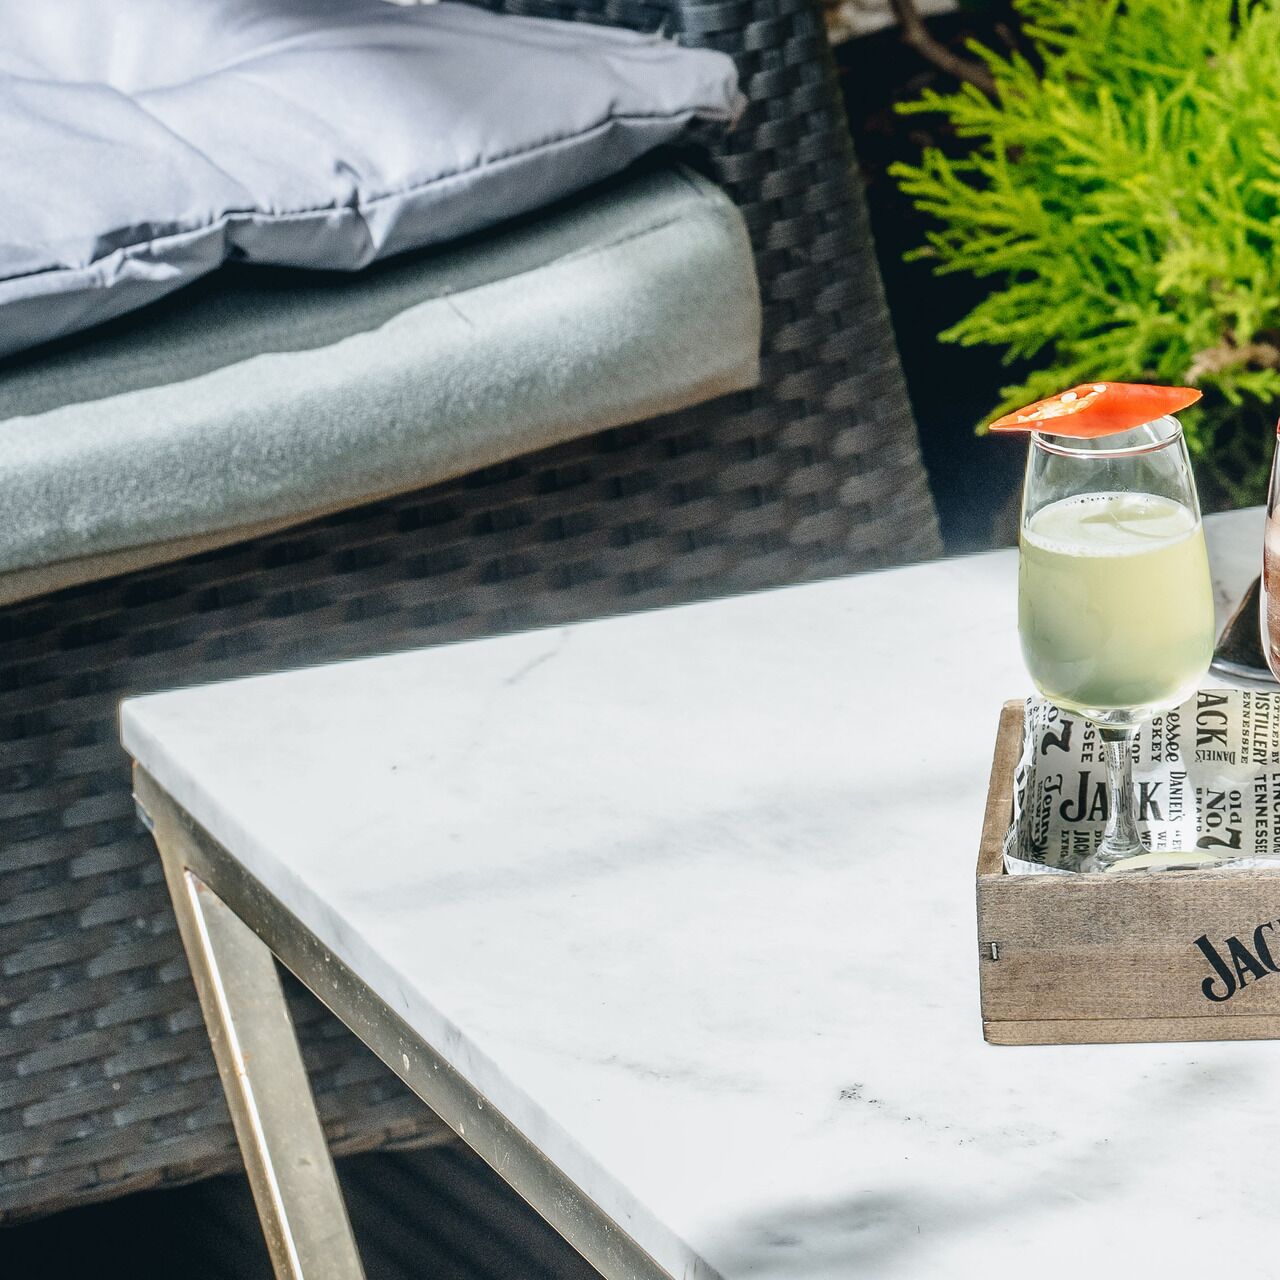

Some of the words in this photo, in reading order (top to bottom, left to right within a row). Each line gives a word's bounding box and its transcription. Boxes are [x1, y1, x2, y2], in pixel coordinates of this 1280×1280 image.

[1151, 716, 1162, 763] SKEY
[1165, 711, 1181, 763] essee
[1196, 691, 1229, 747] ACK
[1241, 692, 1251, 764] ENNESSEE
[1272, 696, 1280, 747] OTTLED
[1271, 752, 1280, 764] BY
[1059, 770, 1165, 823] JAK
[1254, 774, 1268, 854] TENNESSEE
[1196, 827, 1242, 851] 7
